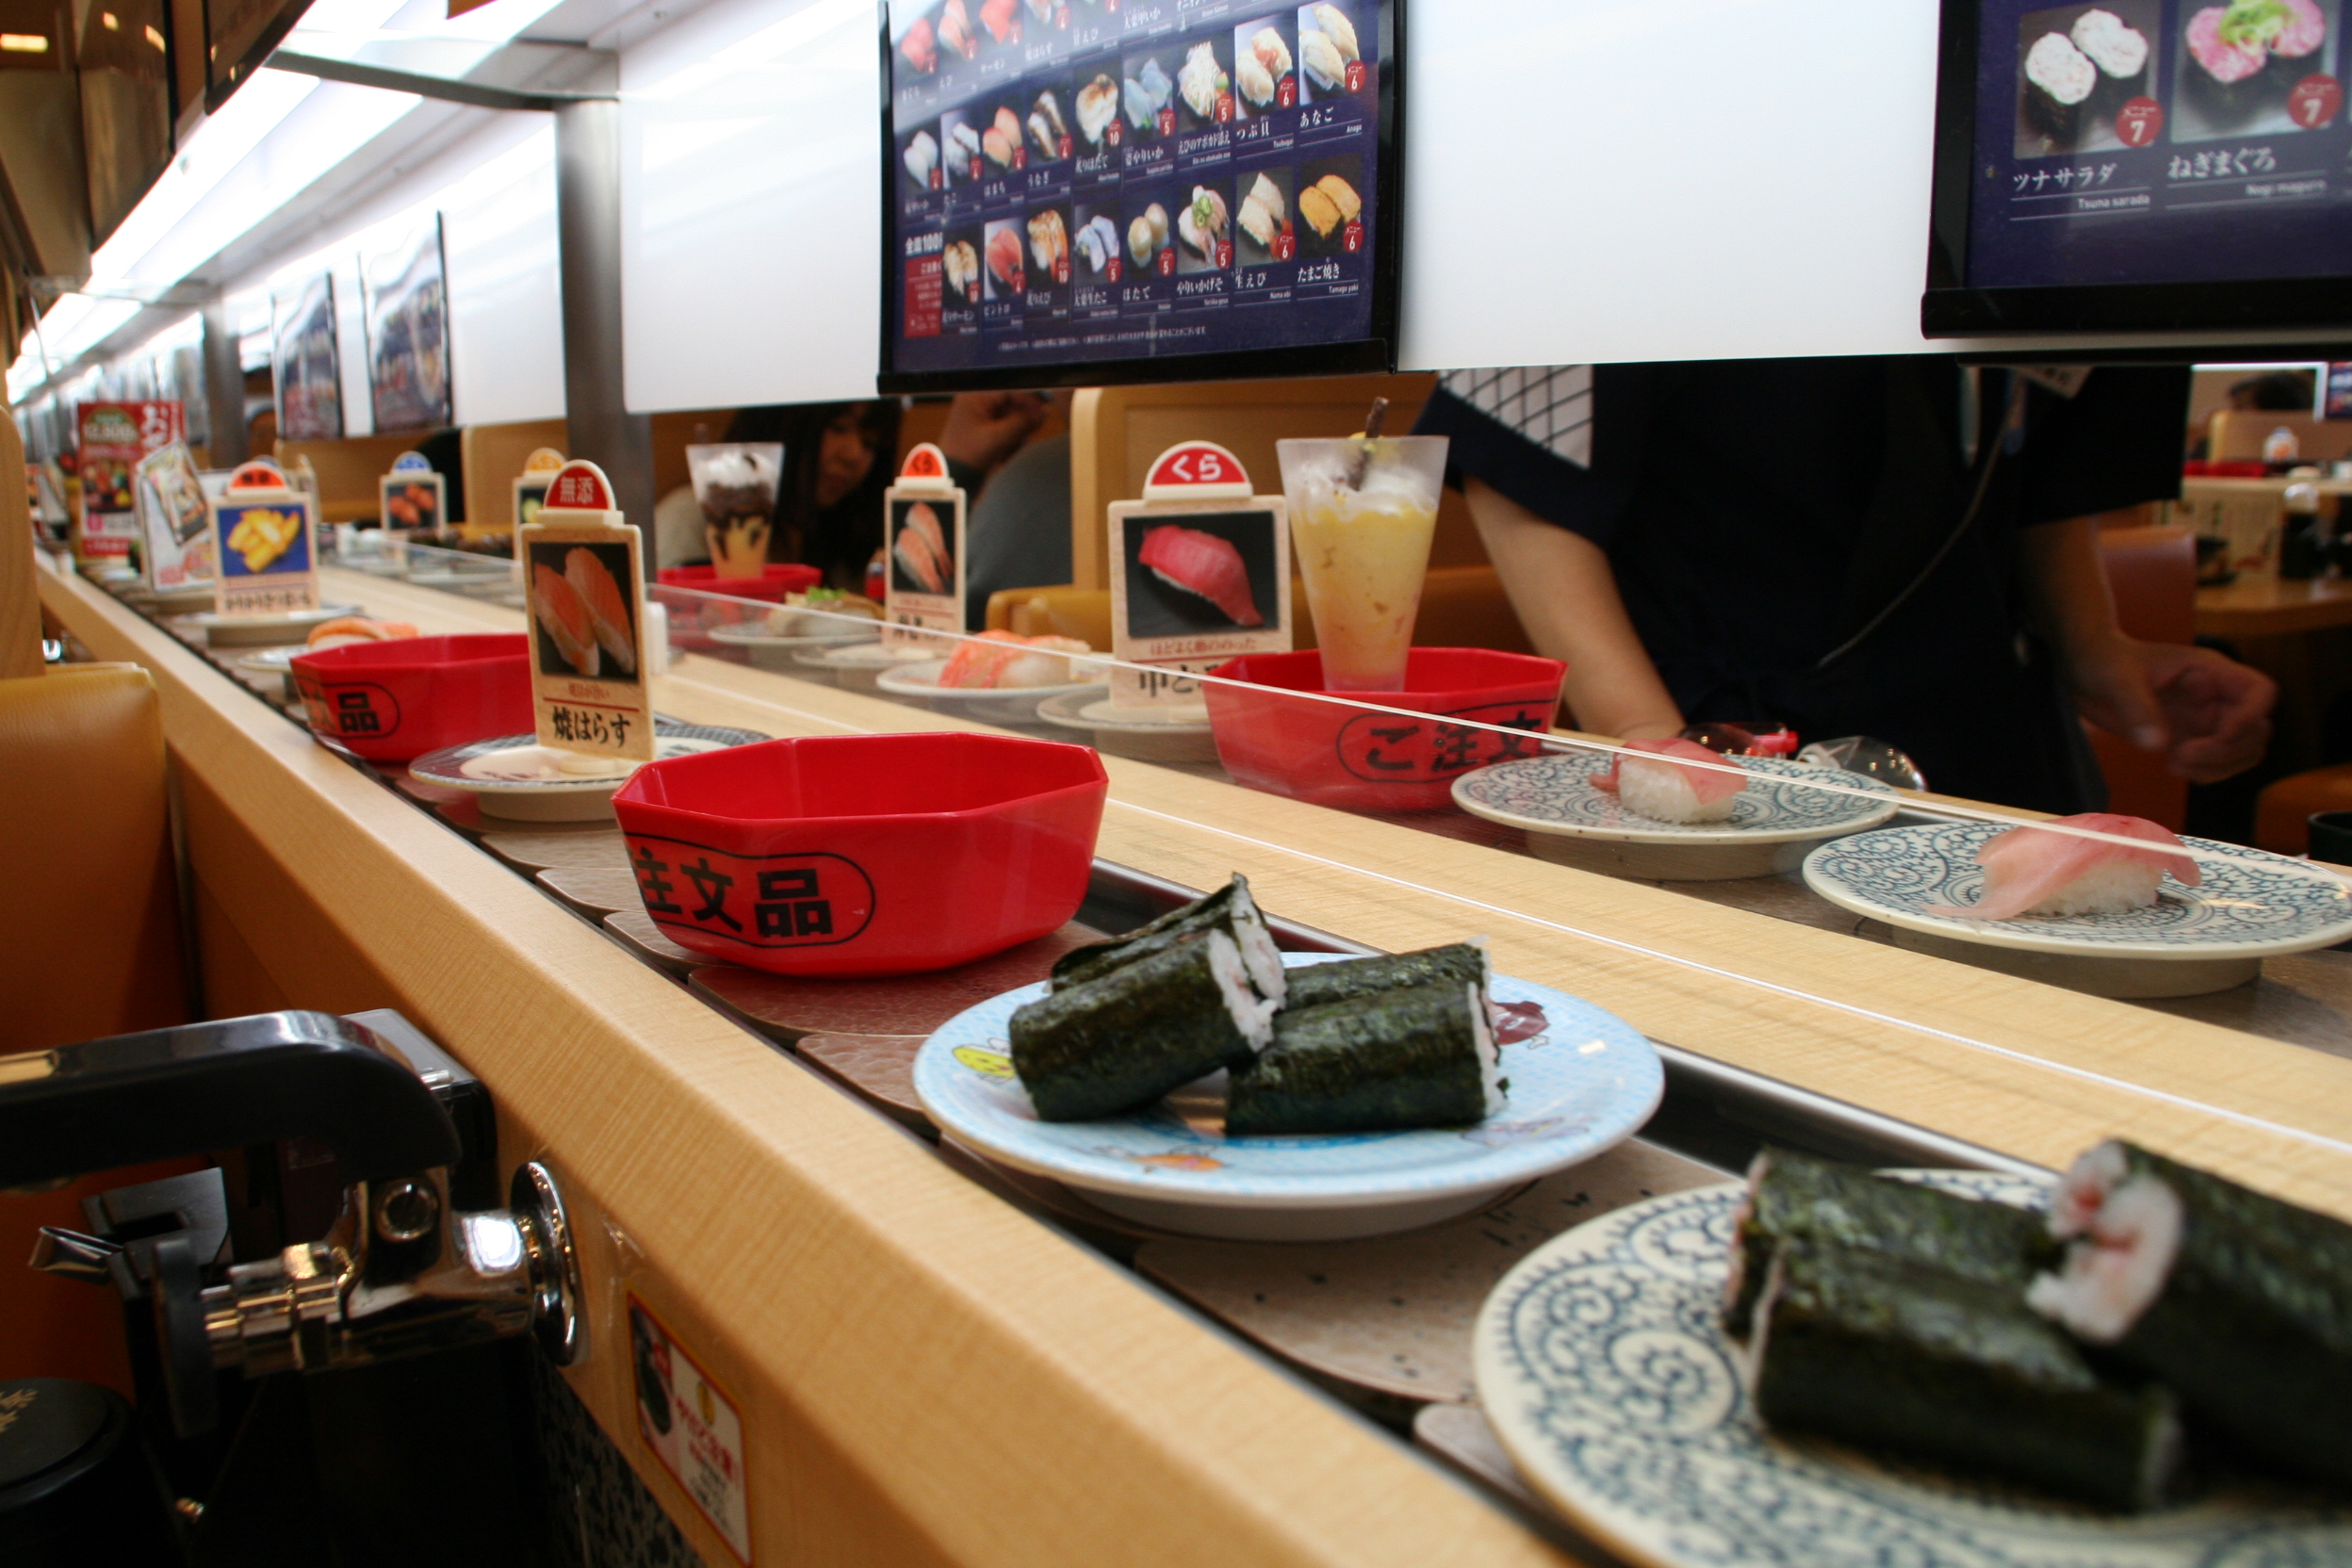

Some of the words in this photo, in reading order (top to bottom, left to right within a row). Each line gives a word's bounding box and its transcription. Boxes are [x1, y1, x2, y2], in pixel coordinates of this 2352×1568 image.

[1350, 75, 1358, 90] 6
[1282, 91, 1290, 106] 6
[1220, 107, 1228, 121] 5
[1300, 106, 1334, 127] あなご
[2302, 97, 2323, 123] 7
[1164, 122, 1169, 135] 5
[1347, 123, 1363, 134] Anago
[2130, 120, 2146, 142] 7
[1109, 133, 1119, 145] 10
[2167, 147, 2277, 179] ねぎまぐろ
[2013, 163, 2117, 191] ツナサラダ
[2078, 194, 2110, 209] Tsuna
[2112, 192, 2150, 206] sarada
[1348, 236, 1356, 251] 6
[1282, 245, 1288, 259] 6
[1163, 261, 1168, 274] 5
[1220, 253, 1226, 267] 5
[1059, 270, 1068, 283] 10
[1110, 269, 1116, 282] 5
[1298, 263, 1340, 283] たまご焼き
[1122, 286, 1151, 302] ほたて
[1329, 285, 1347, 295] Tamago
[1348, 284, 1359, 294] yaki
[1171, 453, 1222, 482] くら
[552, 706, 630, 747] 焼はらす
